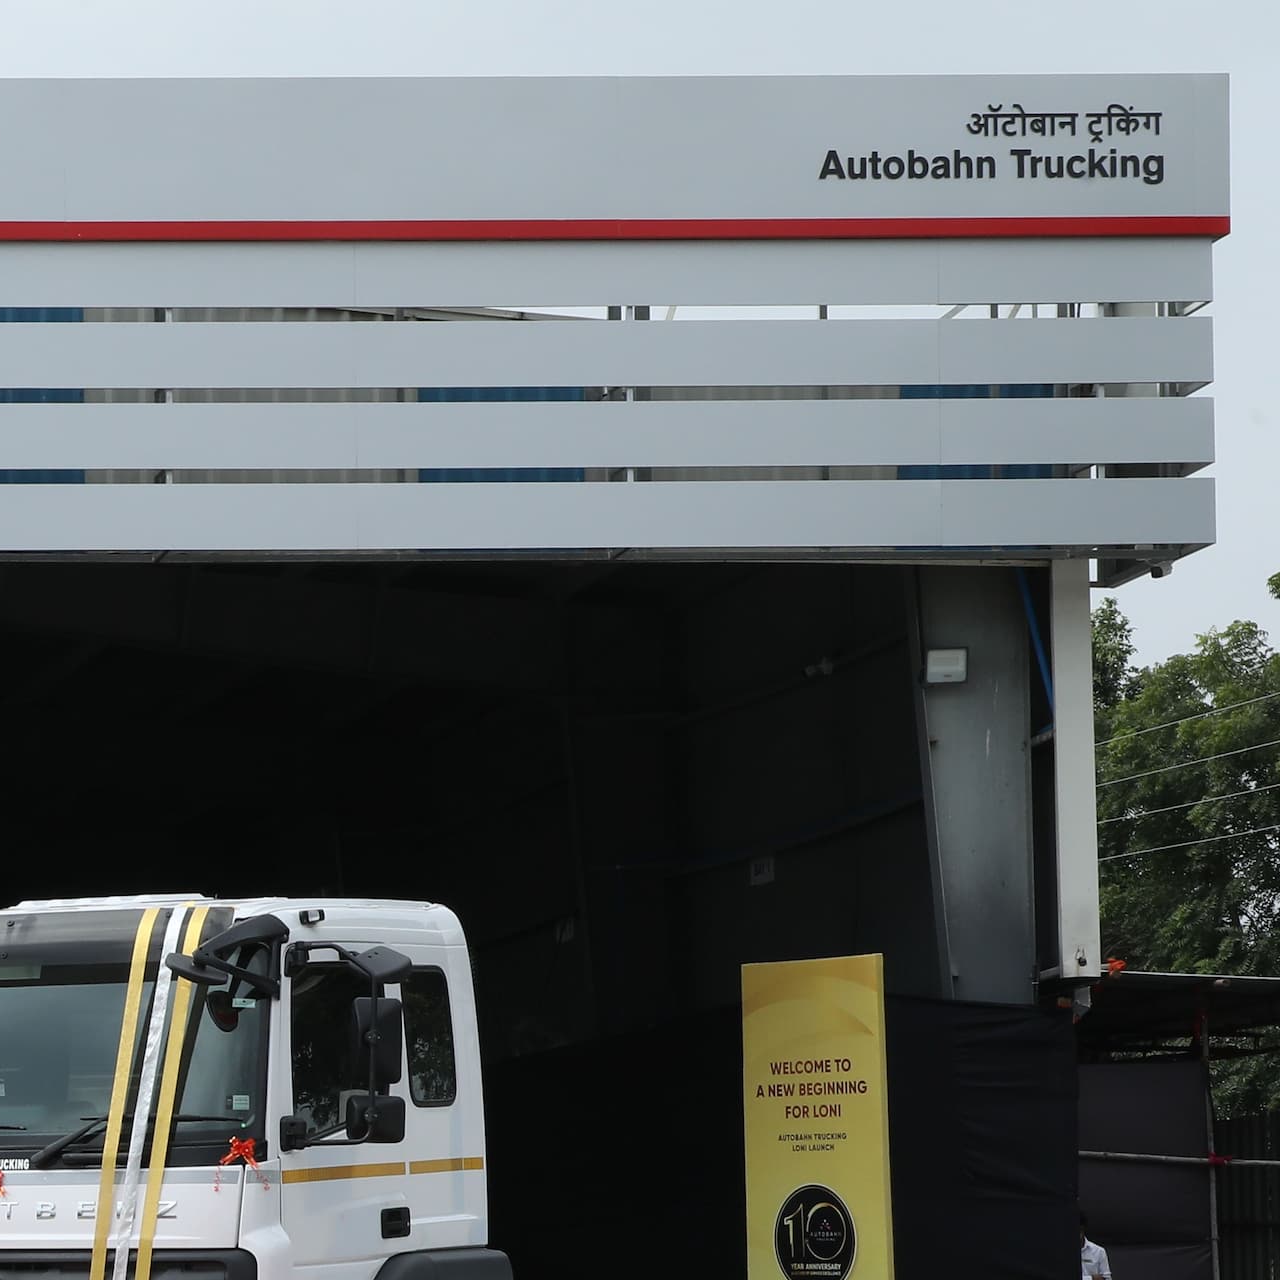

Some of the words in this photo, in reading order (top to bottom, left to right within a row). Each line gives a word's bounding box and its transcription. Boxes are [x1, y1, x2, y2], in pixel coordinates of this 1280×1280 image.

[966, 104, 1078, 137] ऑटोबान
[1086, 104, 1163, 143] ट्रकिंग
[818, 149, 996, 180] Autobahn
[1010, 149, 1165, 185] Trucking
[769, 1060, 832, 1076] WELCOME
[834, 1058, 852, 1073] TO
[756, 1084, 765, 1098] A
[768, 1083, 795, 1098] NEW
[799, 1080, 868, 1096] BEGINNING
[785, 1105, 810, 1119] FOR
[813, 1104, 842, 1118] LONI
[814, 1132, 847, 1140] TRUCKING
[808, 1143, 835, 1152] LAUNCH
